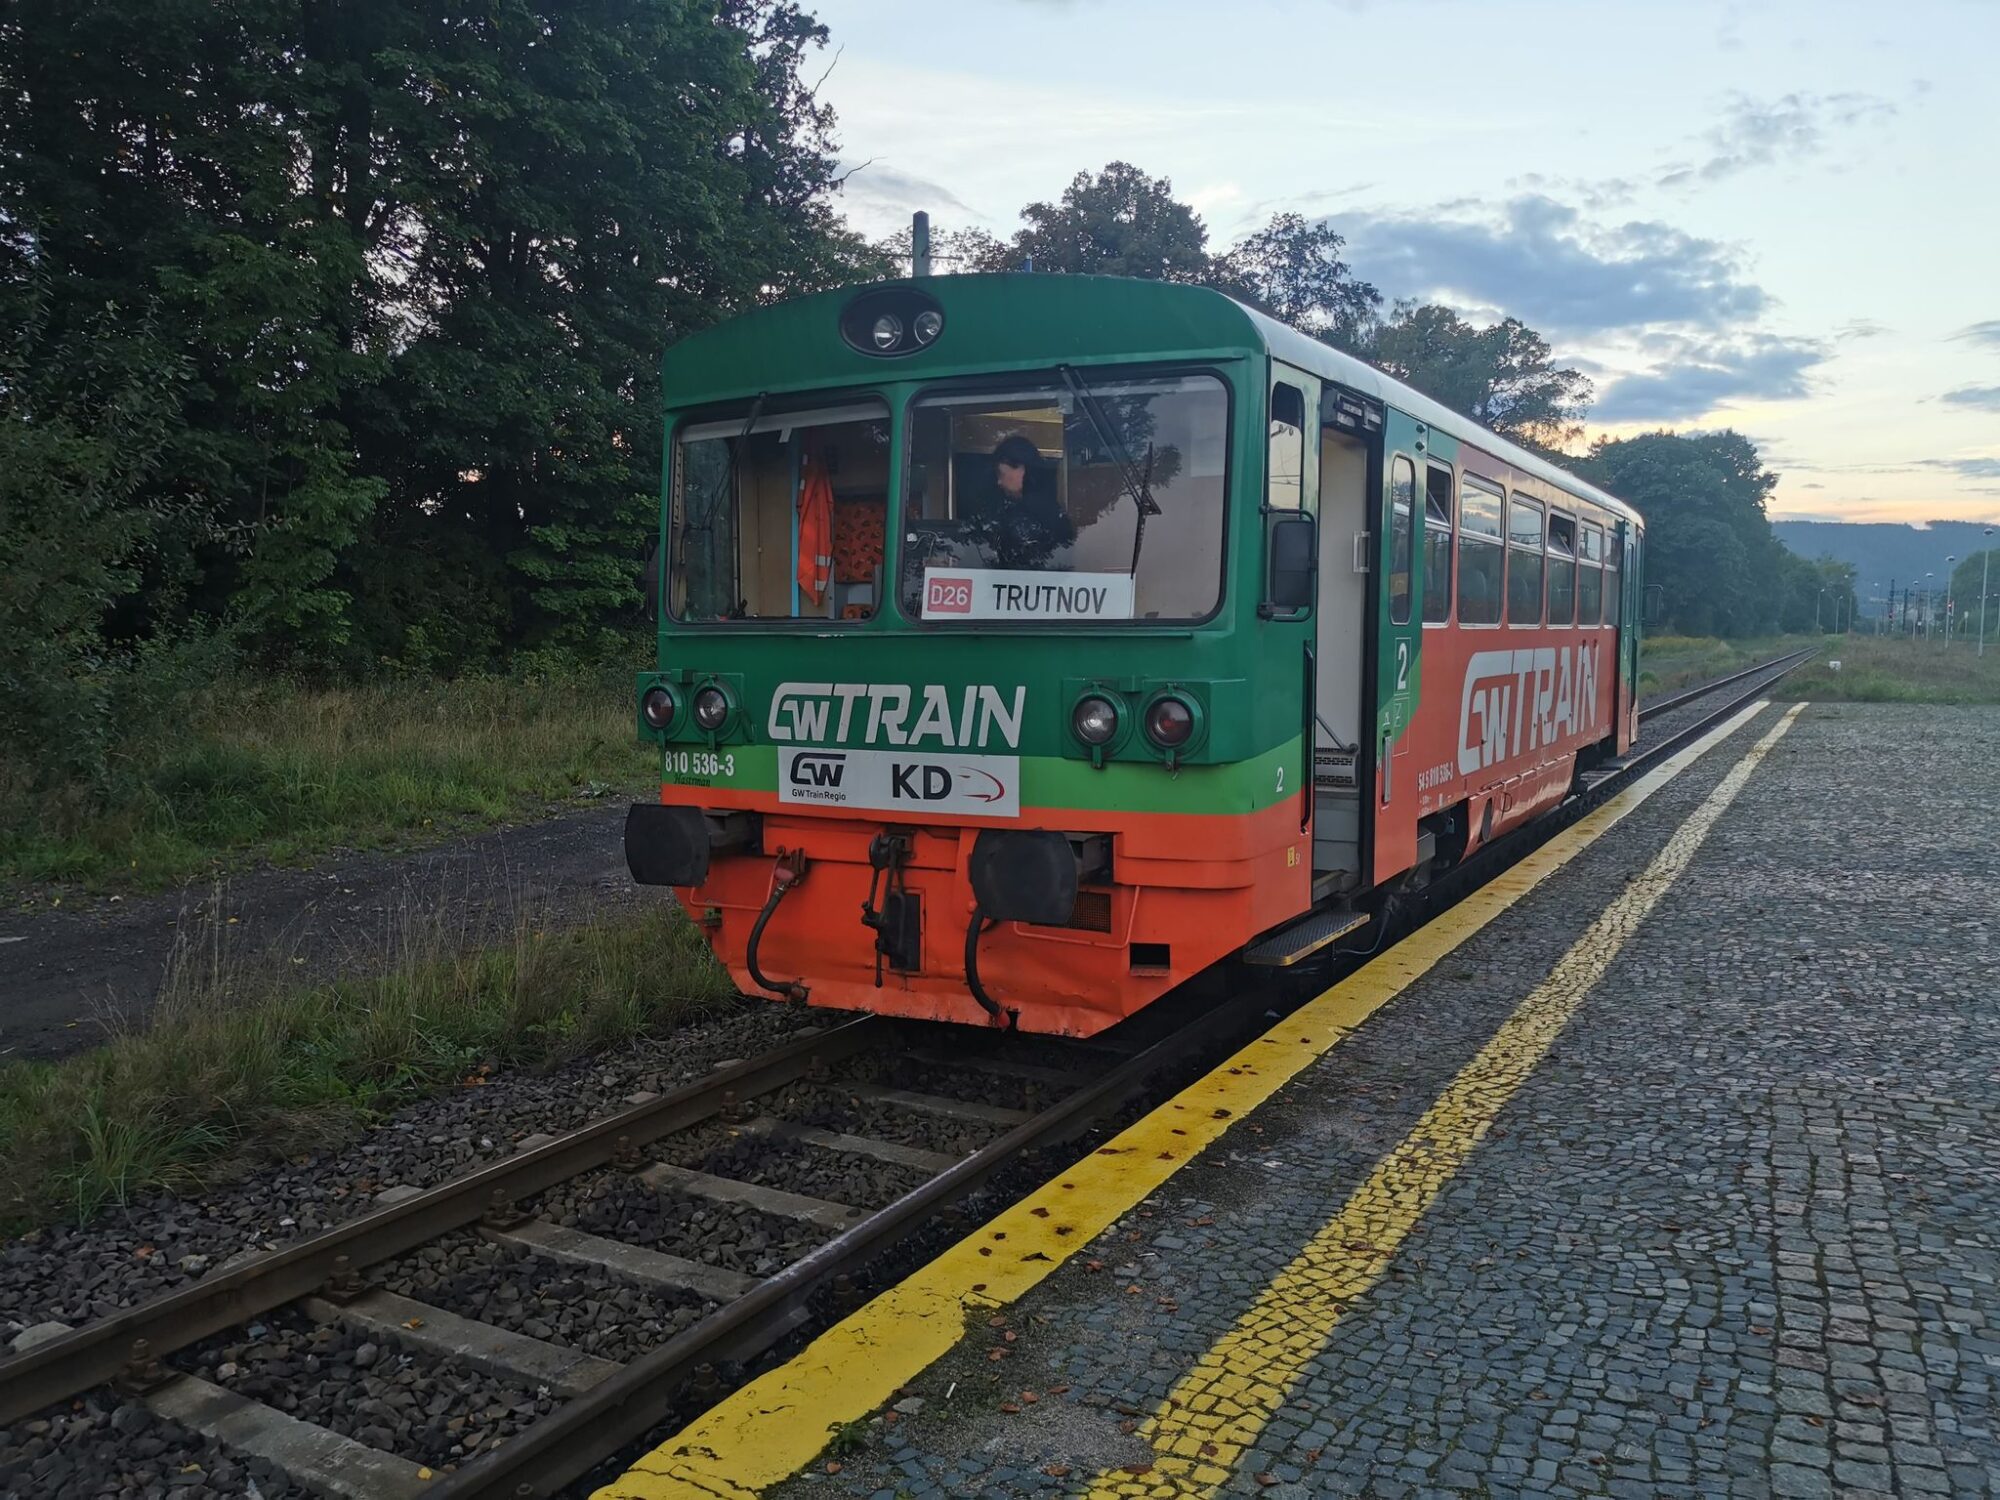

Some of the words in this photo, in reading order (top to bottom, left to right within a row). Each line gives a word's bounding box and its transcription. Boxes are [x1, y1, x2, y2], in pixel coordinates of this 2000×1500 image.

[931, 585, 969, 606] D26
[992, 583, 1107, 614] TRUTNOV
[1397, 642, 1407, 690] 2
[665, 751, 688, 773] 810
[692, 752, 734, 776] 536-3
[790, 752, 847, 787] GW
[892, 764, 952, 800] KD
[1276, 766, 1284, 792] 2
[791, 788, 804, 797] GW
[805, 789, 824, 799] Train
[824, 791, 847, 802] Regio
